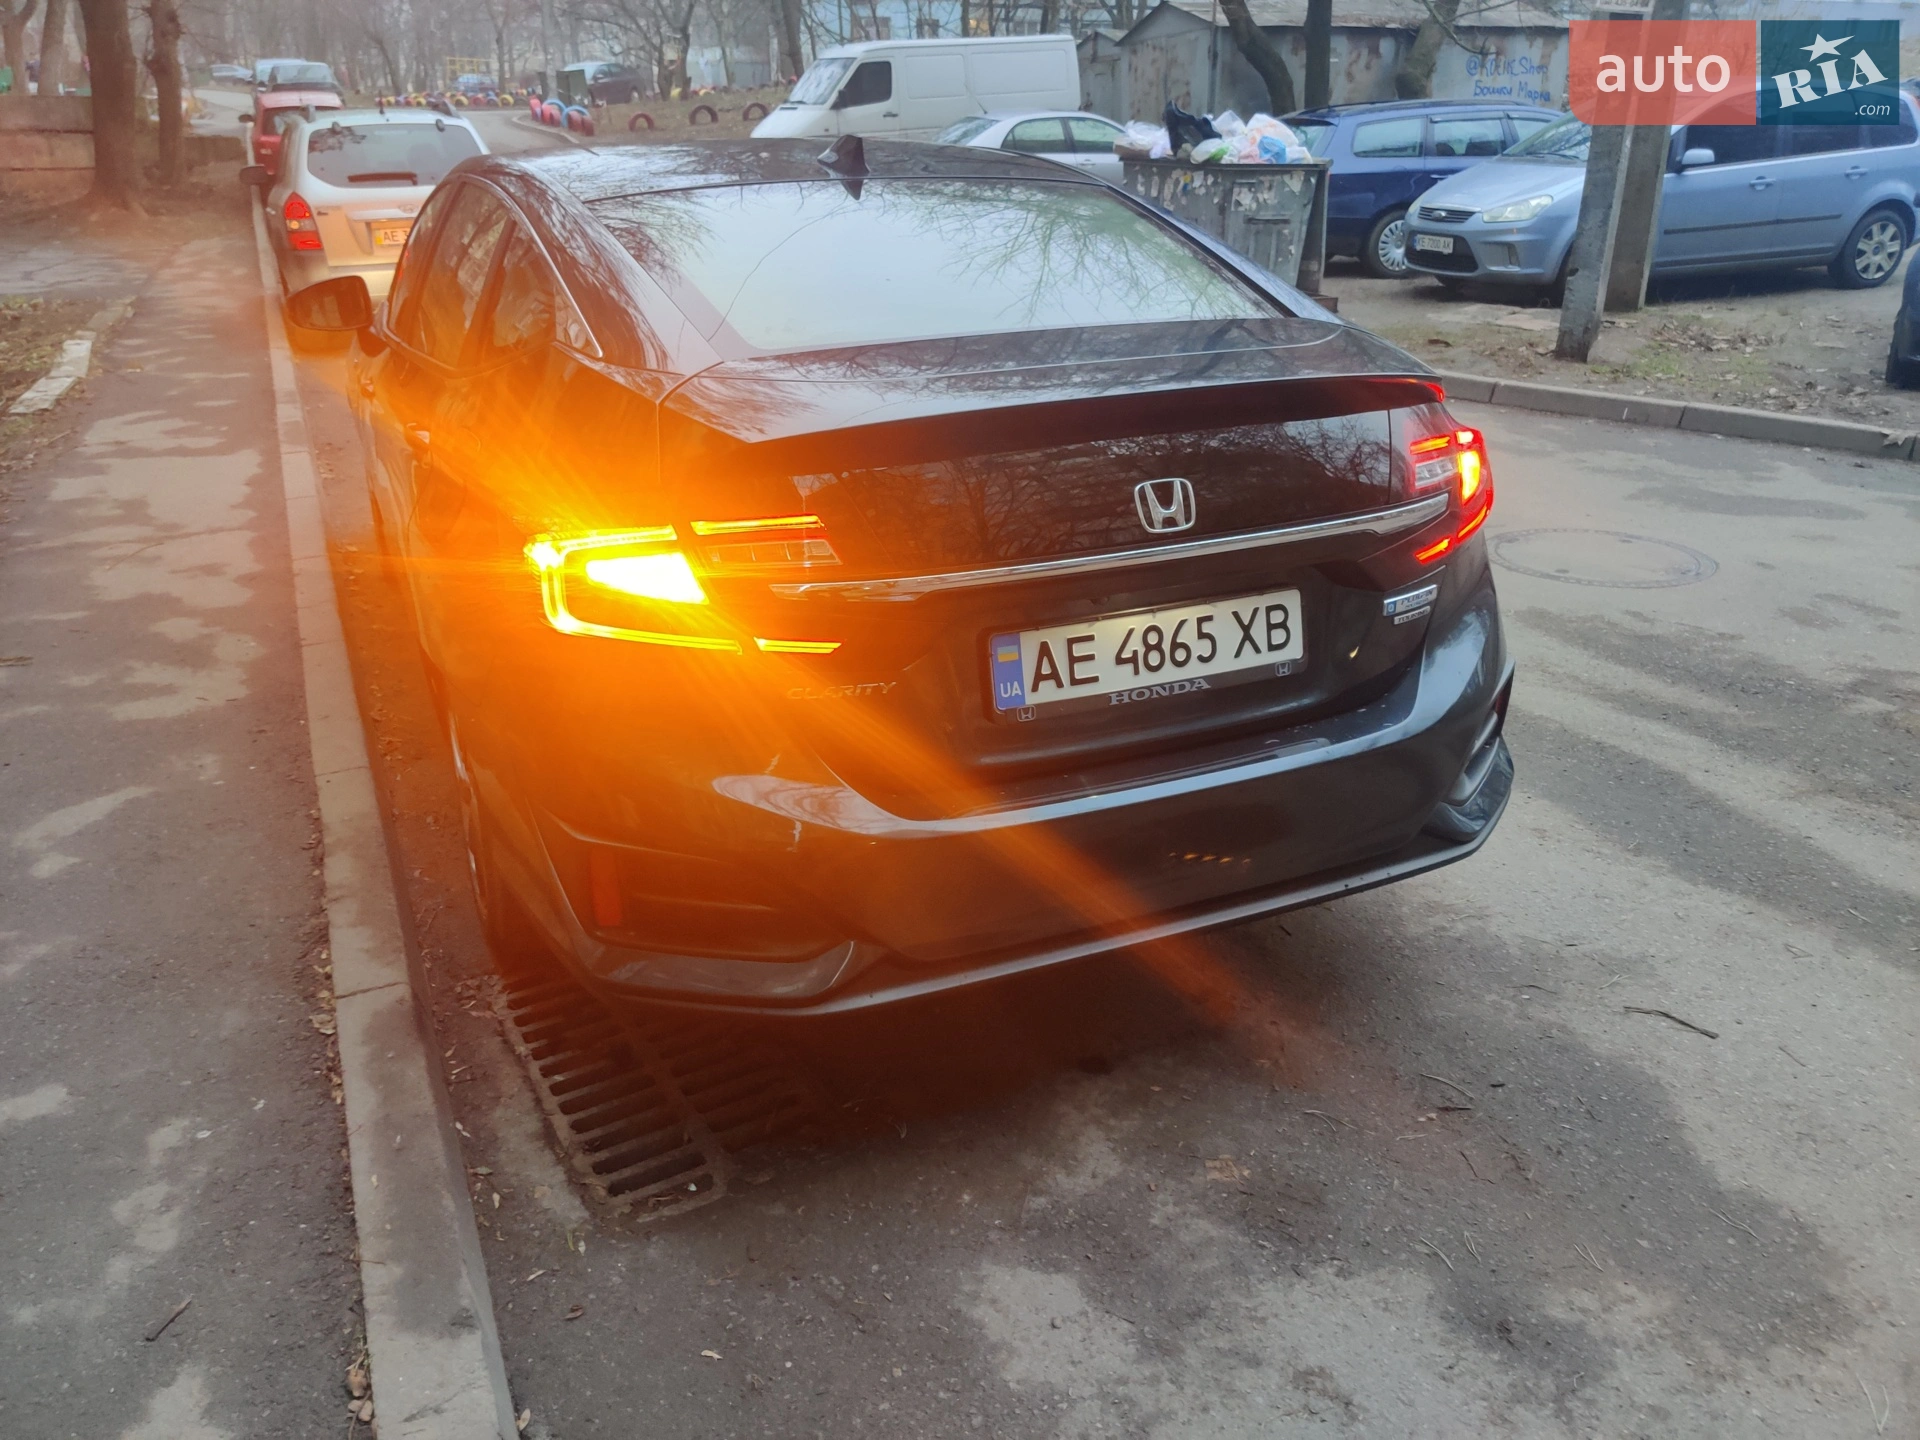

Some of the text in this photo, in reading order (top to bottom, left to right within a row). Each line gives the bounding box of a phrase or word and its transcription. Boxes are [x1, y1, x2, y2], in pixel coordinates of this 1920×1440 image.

[1031, 603, 1292, 693] AE 4865 XB
[787, 682, 897, 699] CLARITY
[1000, 681, 1023, 698] UA
[1108, 678, 1211, 706] HONDA
